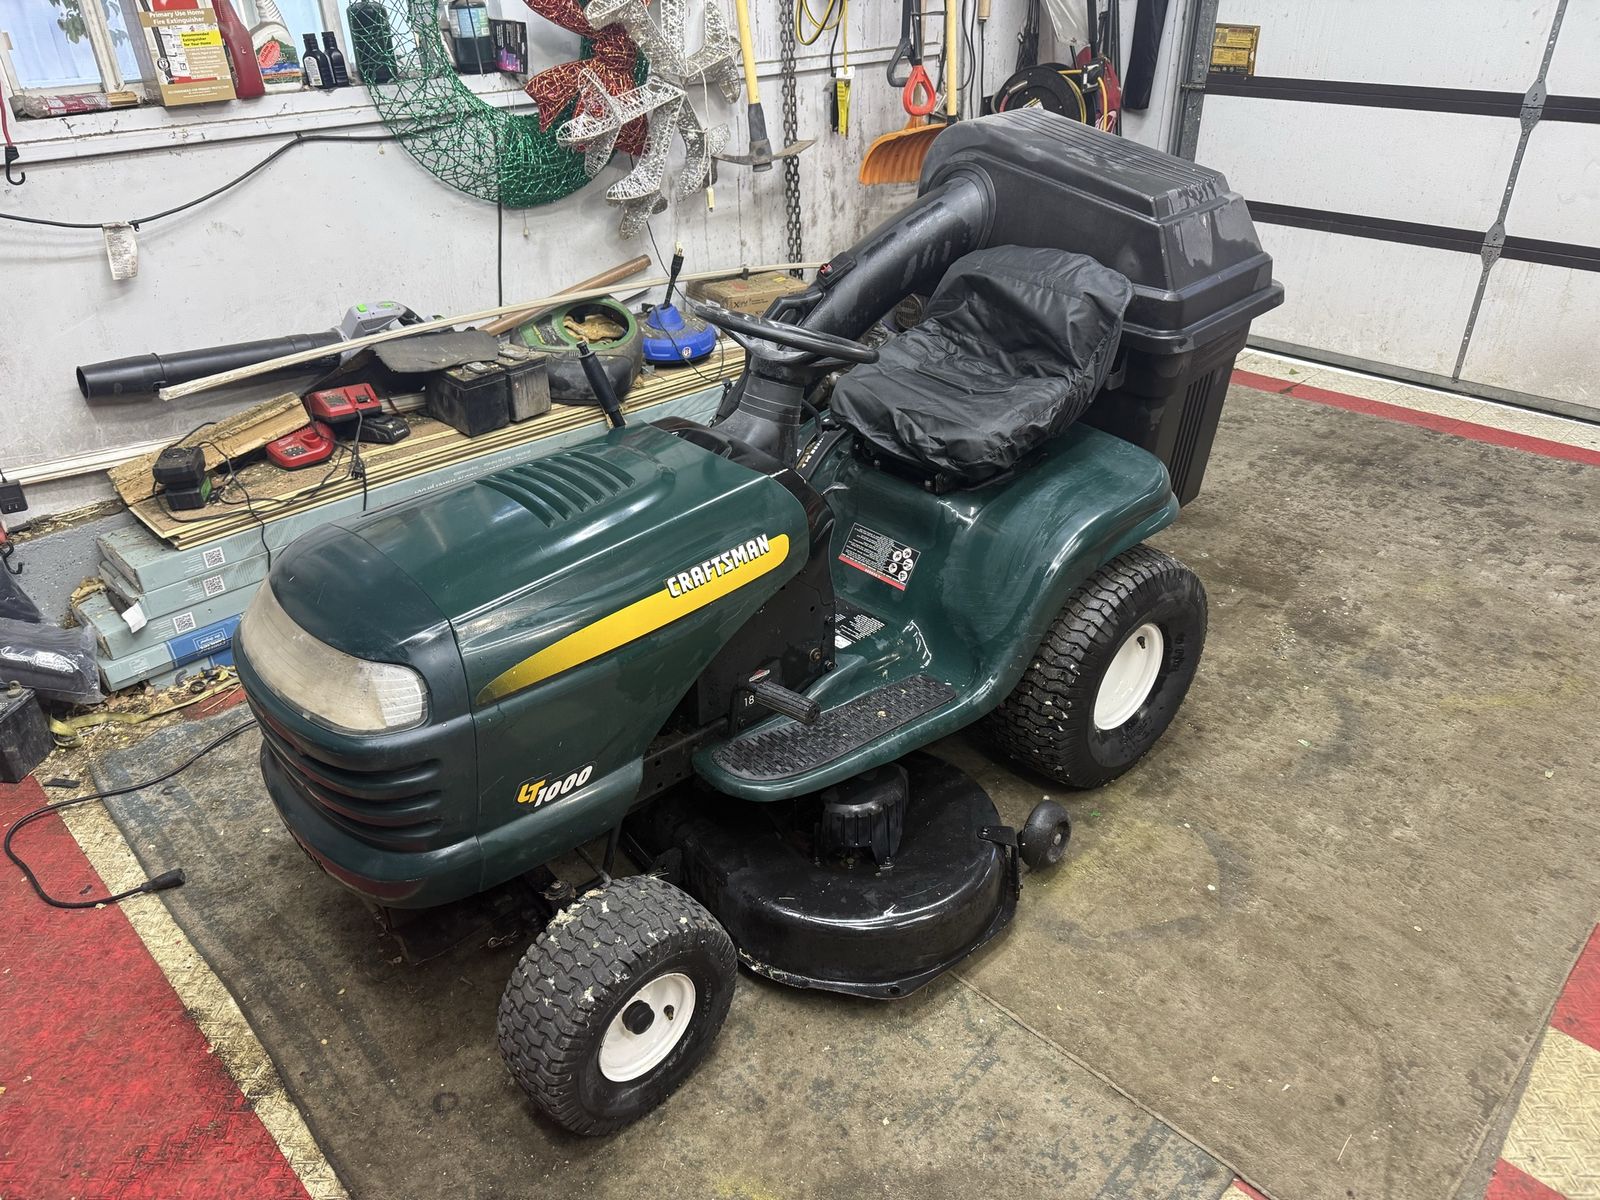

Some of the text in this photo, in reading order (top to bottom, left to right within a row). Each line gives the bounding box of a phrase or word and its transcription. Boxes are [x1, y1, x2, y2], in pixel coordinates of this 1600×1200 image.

[166, 17, 205, 25] Extinguisher
[666, 533, 770, 598] CRAFTSMAN
[744, 694, 754, 706] 18
